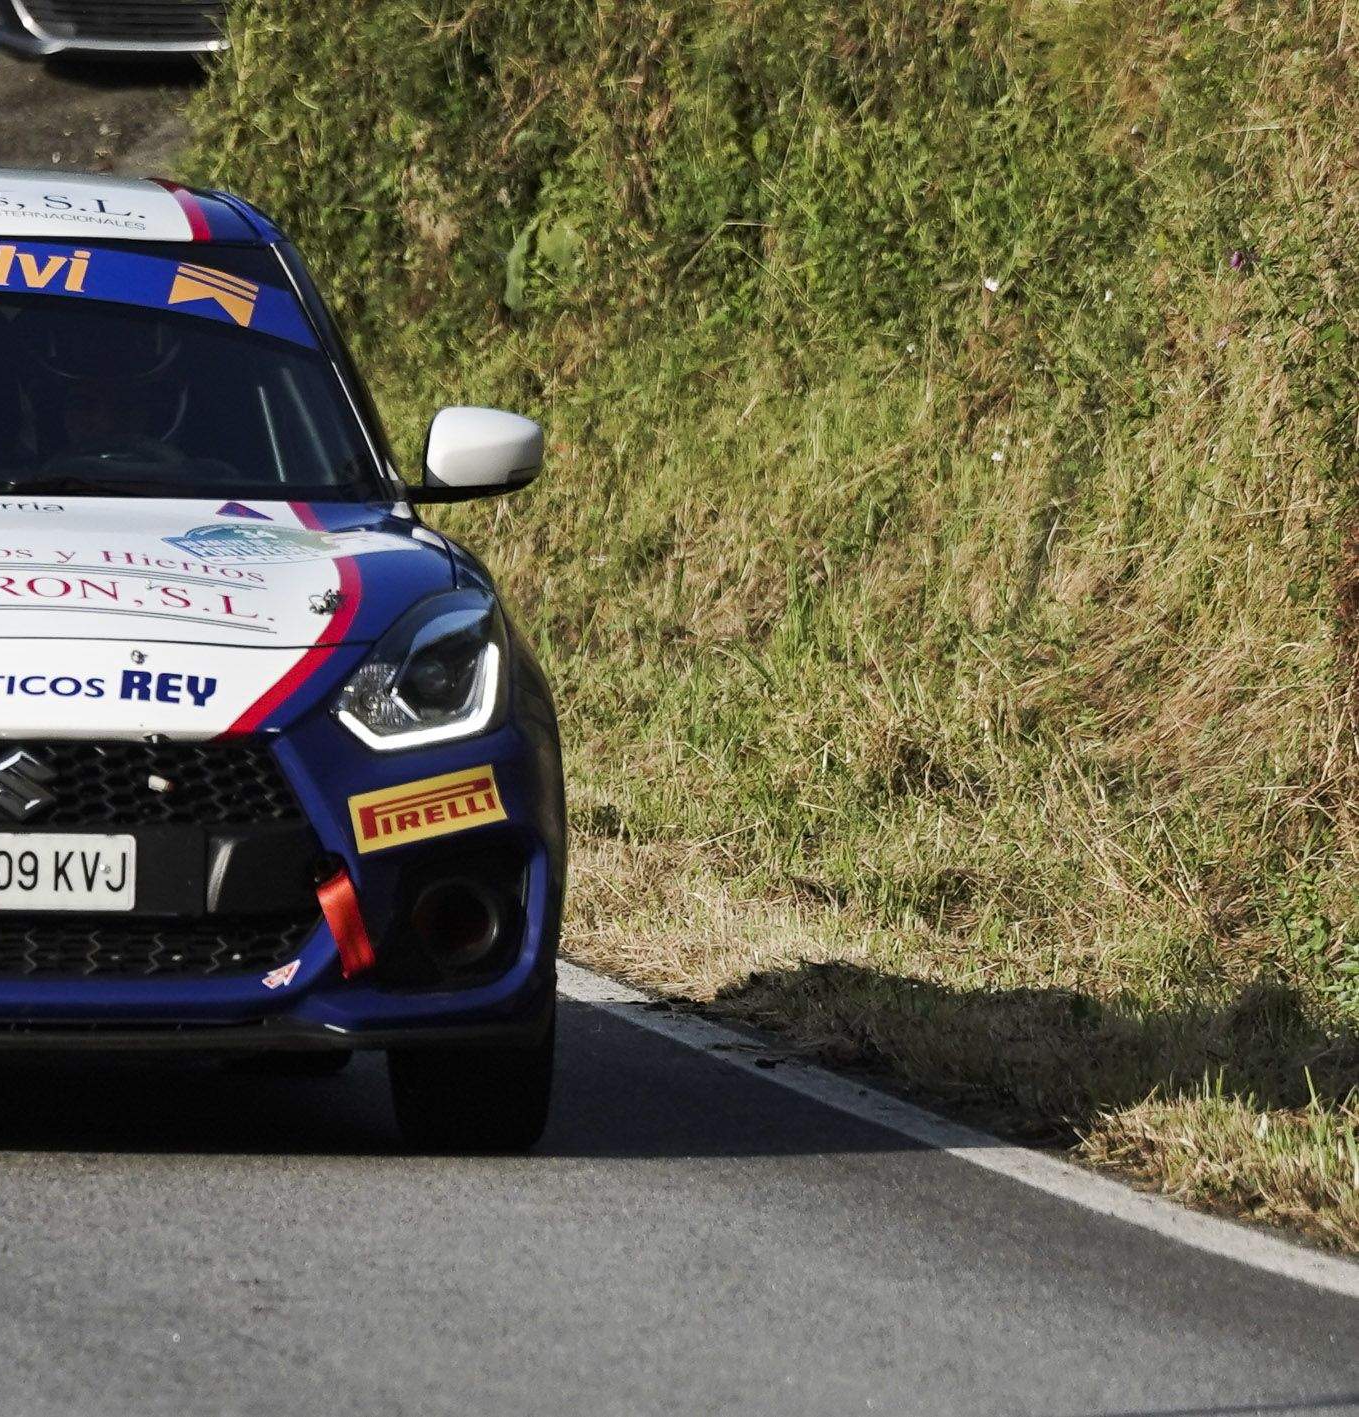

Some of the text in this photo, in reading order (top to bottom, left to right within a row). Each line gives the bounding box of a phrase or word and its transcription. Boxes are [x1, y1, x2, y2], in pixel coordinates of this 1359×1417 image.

[43, 194, 146, 219] S.L.
[55, 550, 76, 564] y
[101, 549, 266, 583] Hierros
[119, 669, 217, 706] REY
[358, 778, 497, 841] PIRELLI
[53, 851, 127, 892] KVJ
